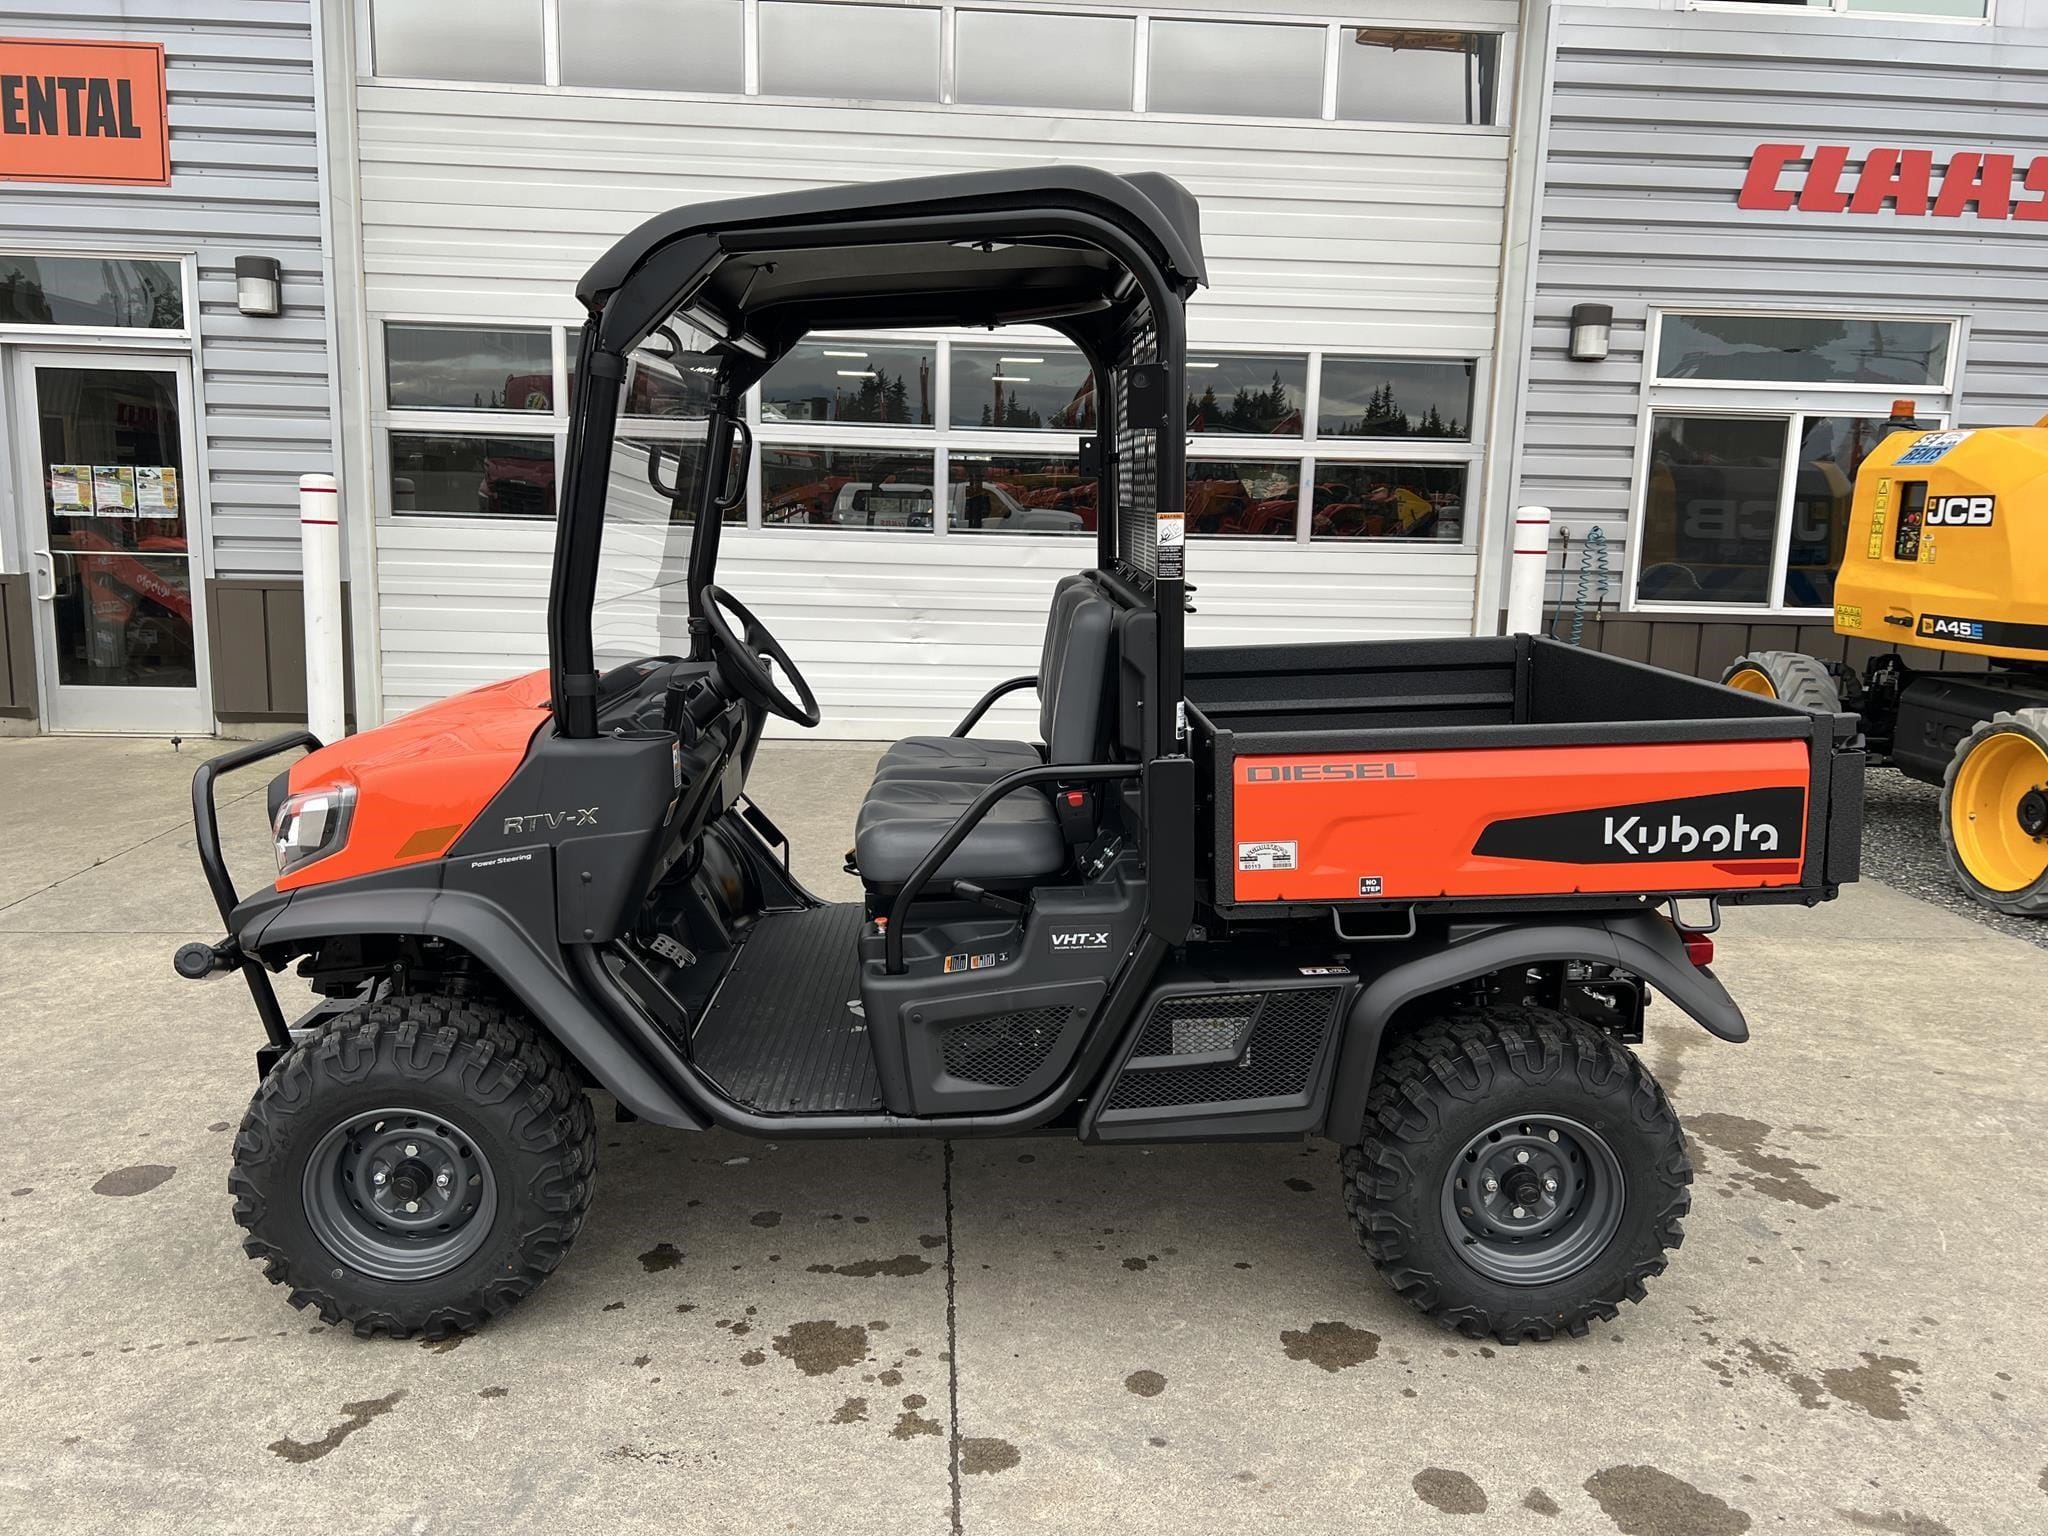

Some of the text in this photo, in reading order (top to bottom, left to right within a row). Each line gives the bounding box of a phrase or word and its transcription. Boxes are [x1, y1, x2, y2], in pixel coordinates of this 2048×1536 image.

[1926, 497, 1993, 525] JCB
[1935, 619, 1983, 637] A45E
[1247, 763, 1416, 782] DIESEL
[503, 807, 599, 835] RTV-X
[1604, 813, 1779, 854] Kubota
[471, 854, 532, 868] Power Steering
[1051, 932, 1109, 945] VHT-X
